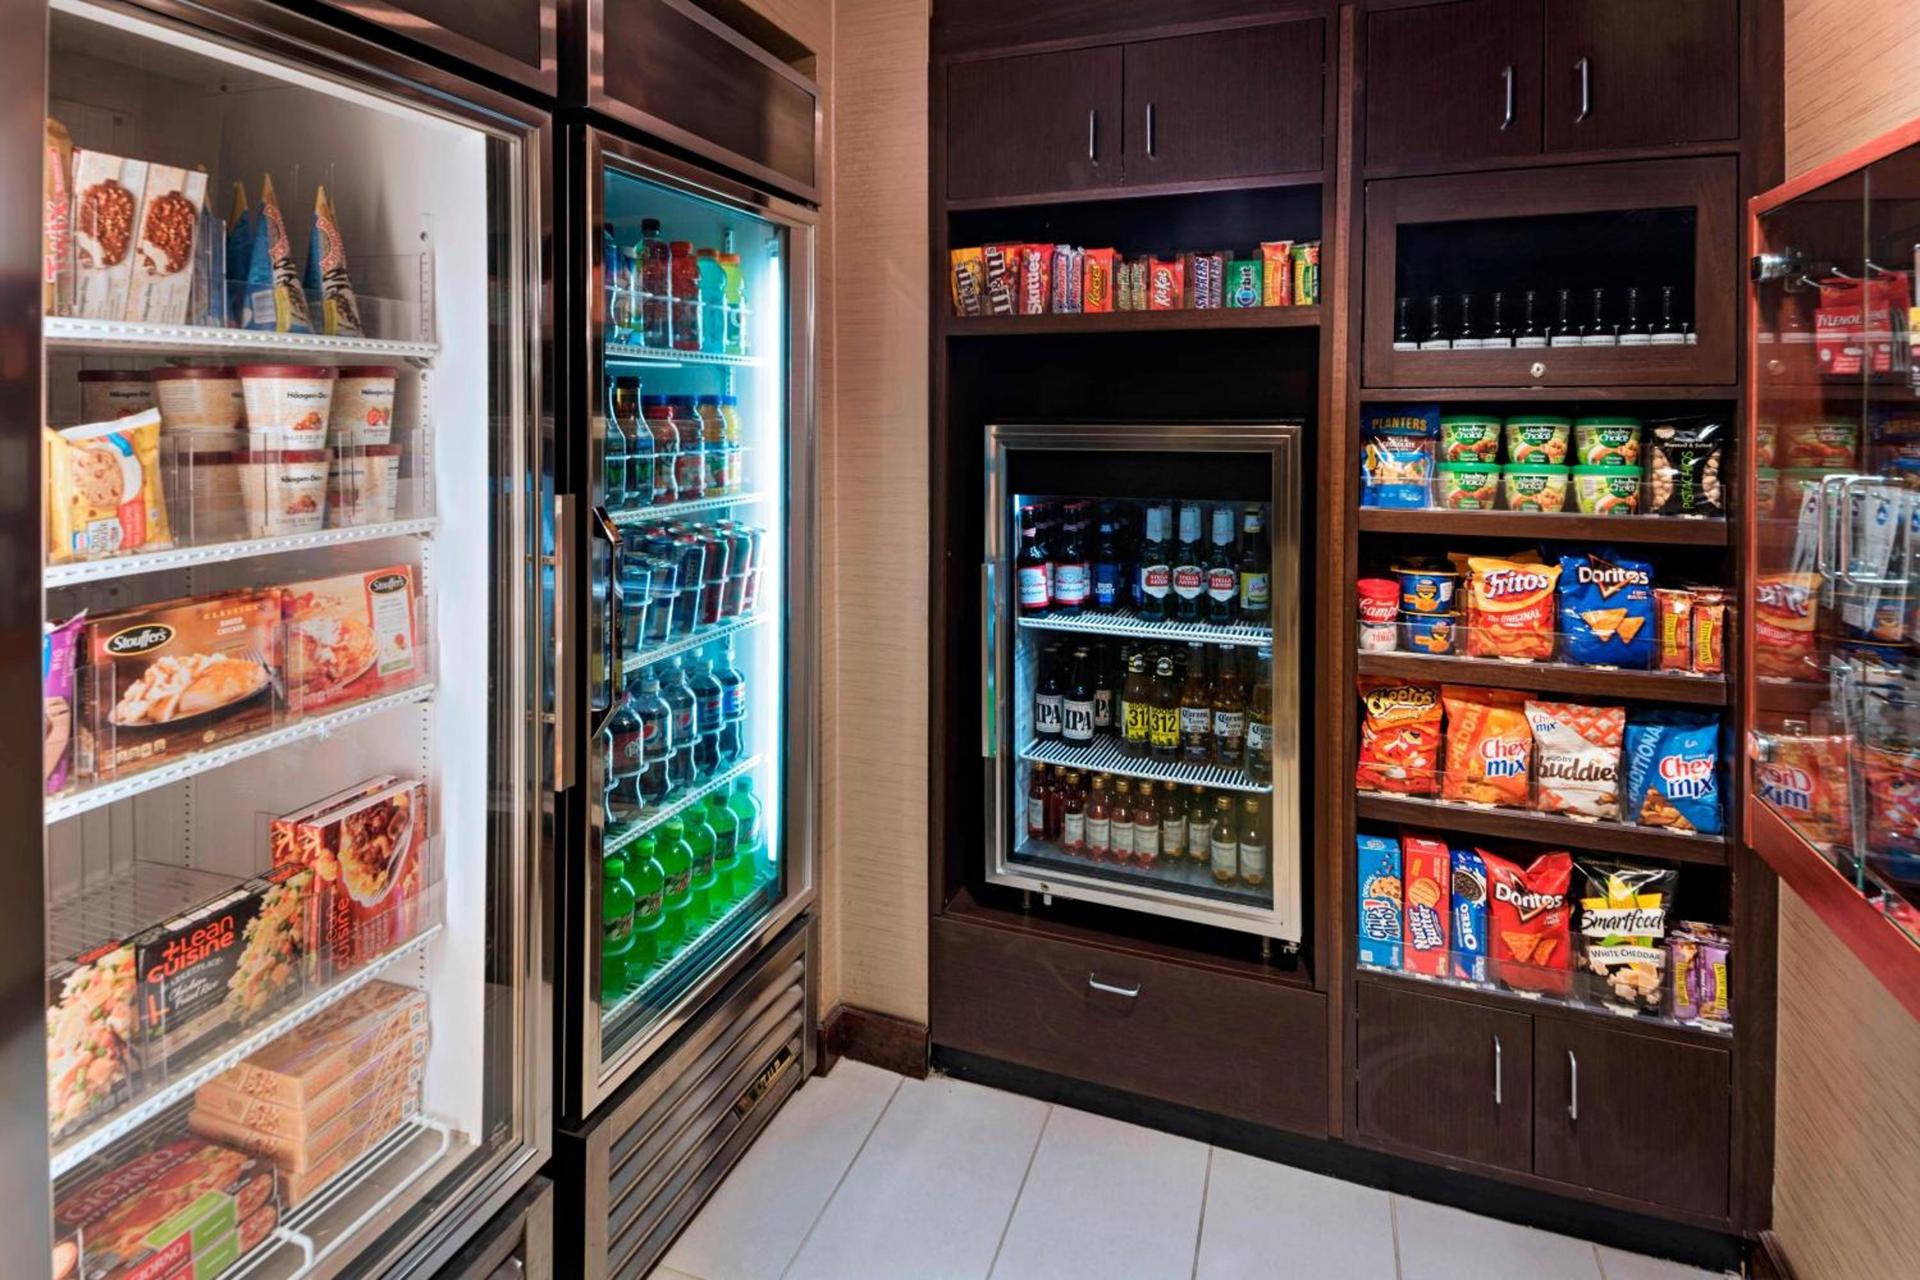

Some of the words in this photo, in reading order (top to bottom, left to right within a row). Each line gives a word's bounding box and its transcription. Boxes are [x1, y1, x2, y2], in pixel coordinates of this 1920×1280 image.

[1026, 252, 1043, 316] Skittles
[1194, 258, 1208, 309] SNICKERS
[1817, 314, 1861, 327] TYLENOL
[1372, 416, 1427, 431] PLANTERS
[1681, 451, 1695, 509] PISTACHIOS
[1483, 569, 1550, 599] Fritos
[1578, 567, 1649, 585] Doritos
[1500, 609, 1542, 622] ORIGINAL
[112, 630, 168, 649] Stouffer's
[1367, 686, 1437, 716] Cheetos
[1037, 703, 1062, 724] IPA
[1065, 709, 1092, 731] IPA
[1151, 714, 1177, 732] 312
[1536, 722, 1556, 732] mix
[1481, 738, 1528, 759] Chex
[1488, 760, 1526, 777] mix
[1660, 754, 1714, 779] Chex
[1668, 777, 1713, 807] mix
[1496, 882, 1563, 910] Doritos
[1366, 908, 1386, 939] Chips
[1407, 908, 1430, 950] Nutter
[1417, 904, 1442, 946] Butter
[1460, 903, 1476, 950] OREO
[1583, 909, 1664, 932] Smartfood
[1591, 949, 1619, 959] WHITE
[1621, 949, 1661, 961] CHEDDAR
